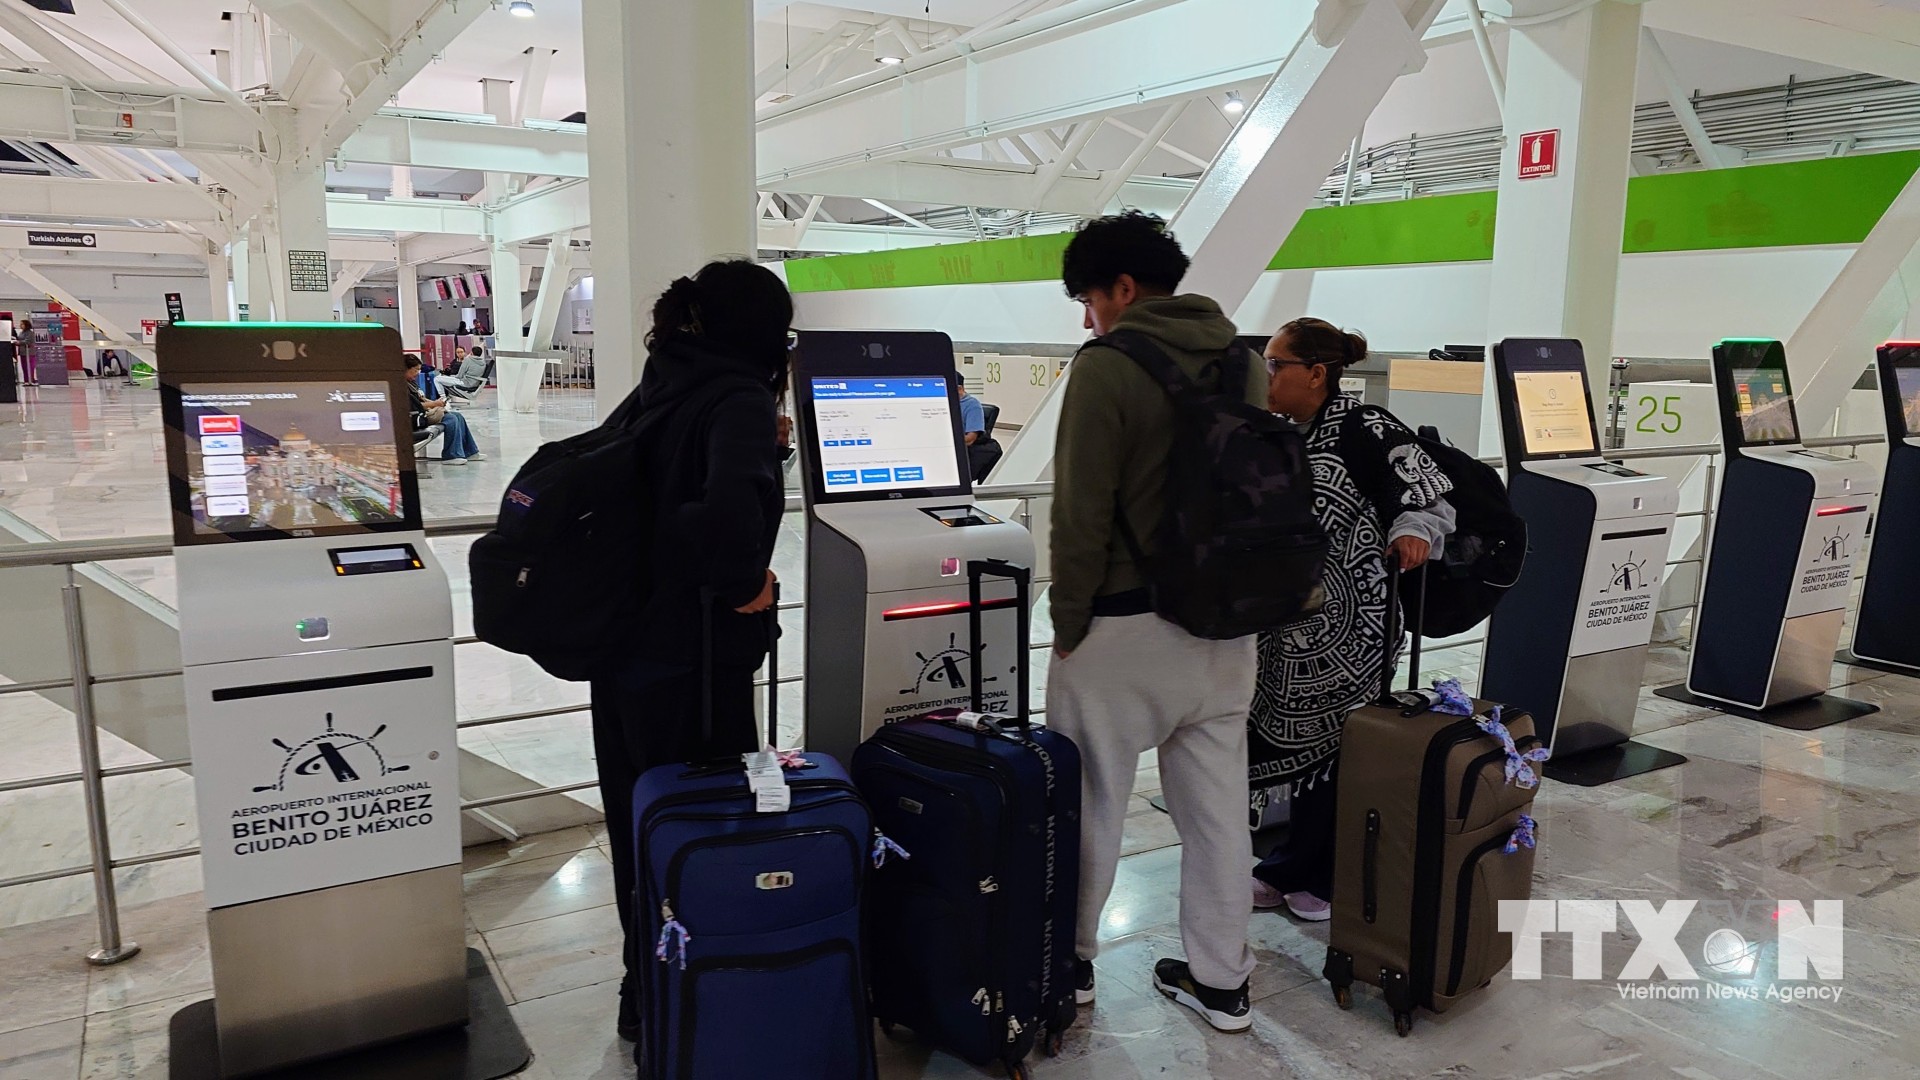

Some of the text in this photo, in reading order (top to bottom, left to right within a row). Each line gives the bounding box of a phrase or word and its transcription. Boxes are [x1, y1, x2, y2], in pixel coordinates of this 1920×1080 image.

[1522, 164, 1551, 173] EXTINTOR
[29, 235, 55, 243] Turkish
[986, 362, 1001, 384] 33
[1029, 363, 1046, 387] 32
[1635, 395, 1682, 434] 25
[1803, 574, 1825, 584] BENITO
[1801, 585, 1820, 593] CIUDAD
[1588, 601, 1650, 618] BENITO JUÁREZ
[1591, 599, 1618, 607] AEROPUERTO
[1586, 613, 1647, 628] CIUDAD DE MÉXICO
[884, 699, 942, 715] AEROPUERTO
[231, 781, 433, 819] AEROPUERTO INTERNACIONAL
[232, 793, 434, 839] BENITO JUÁREZ
[233, 812, 434, 856] CIUDAD DE MÉXICO
